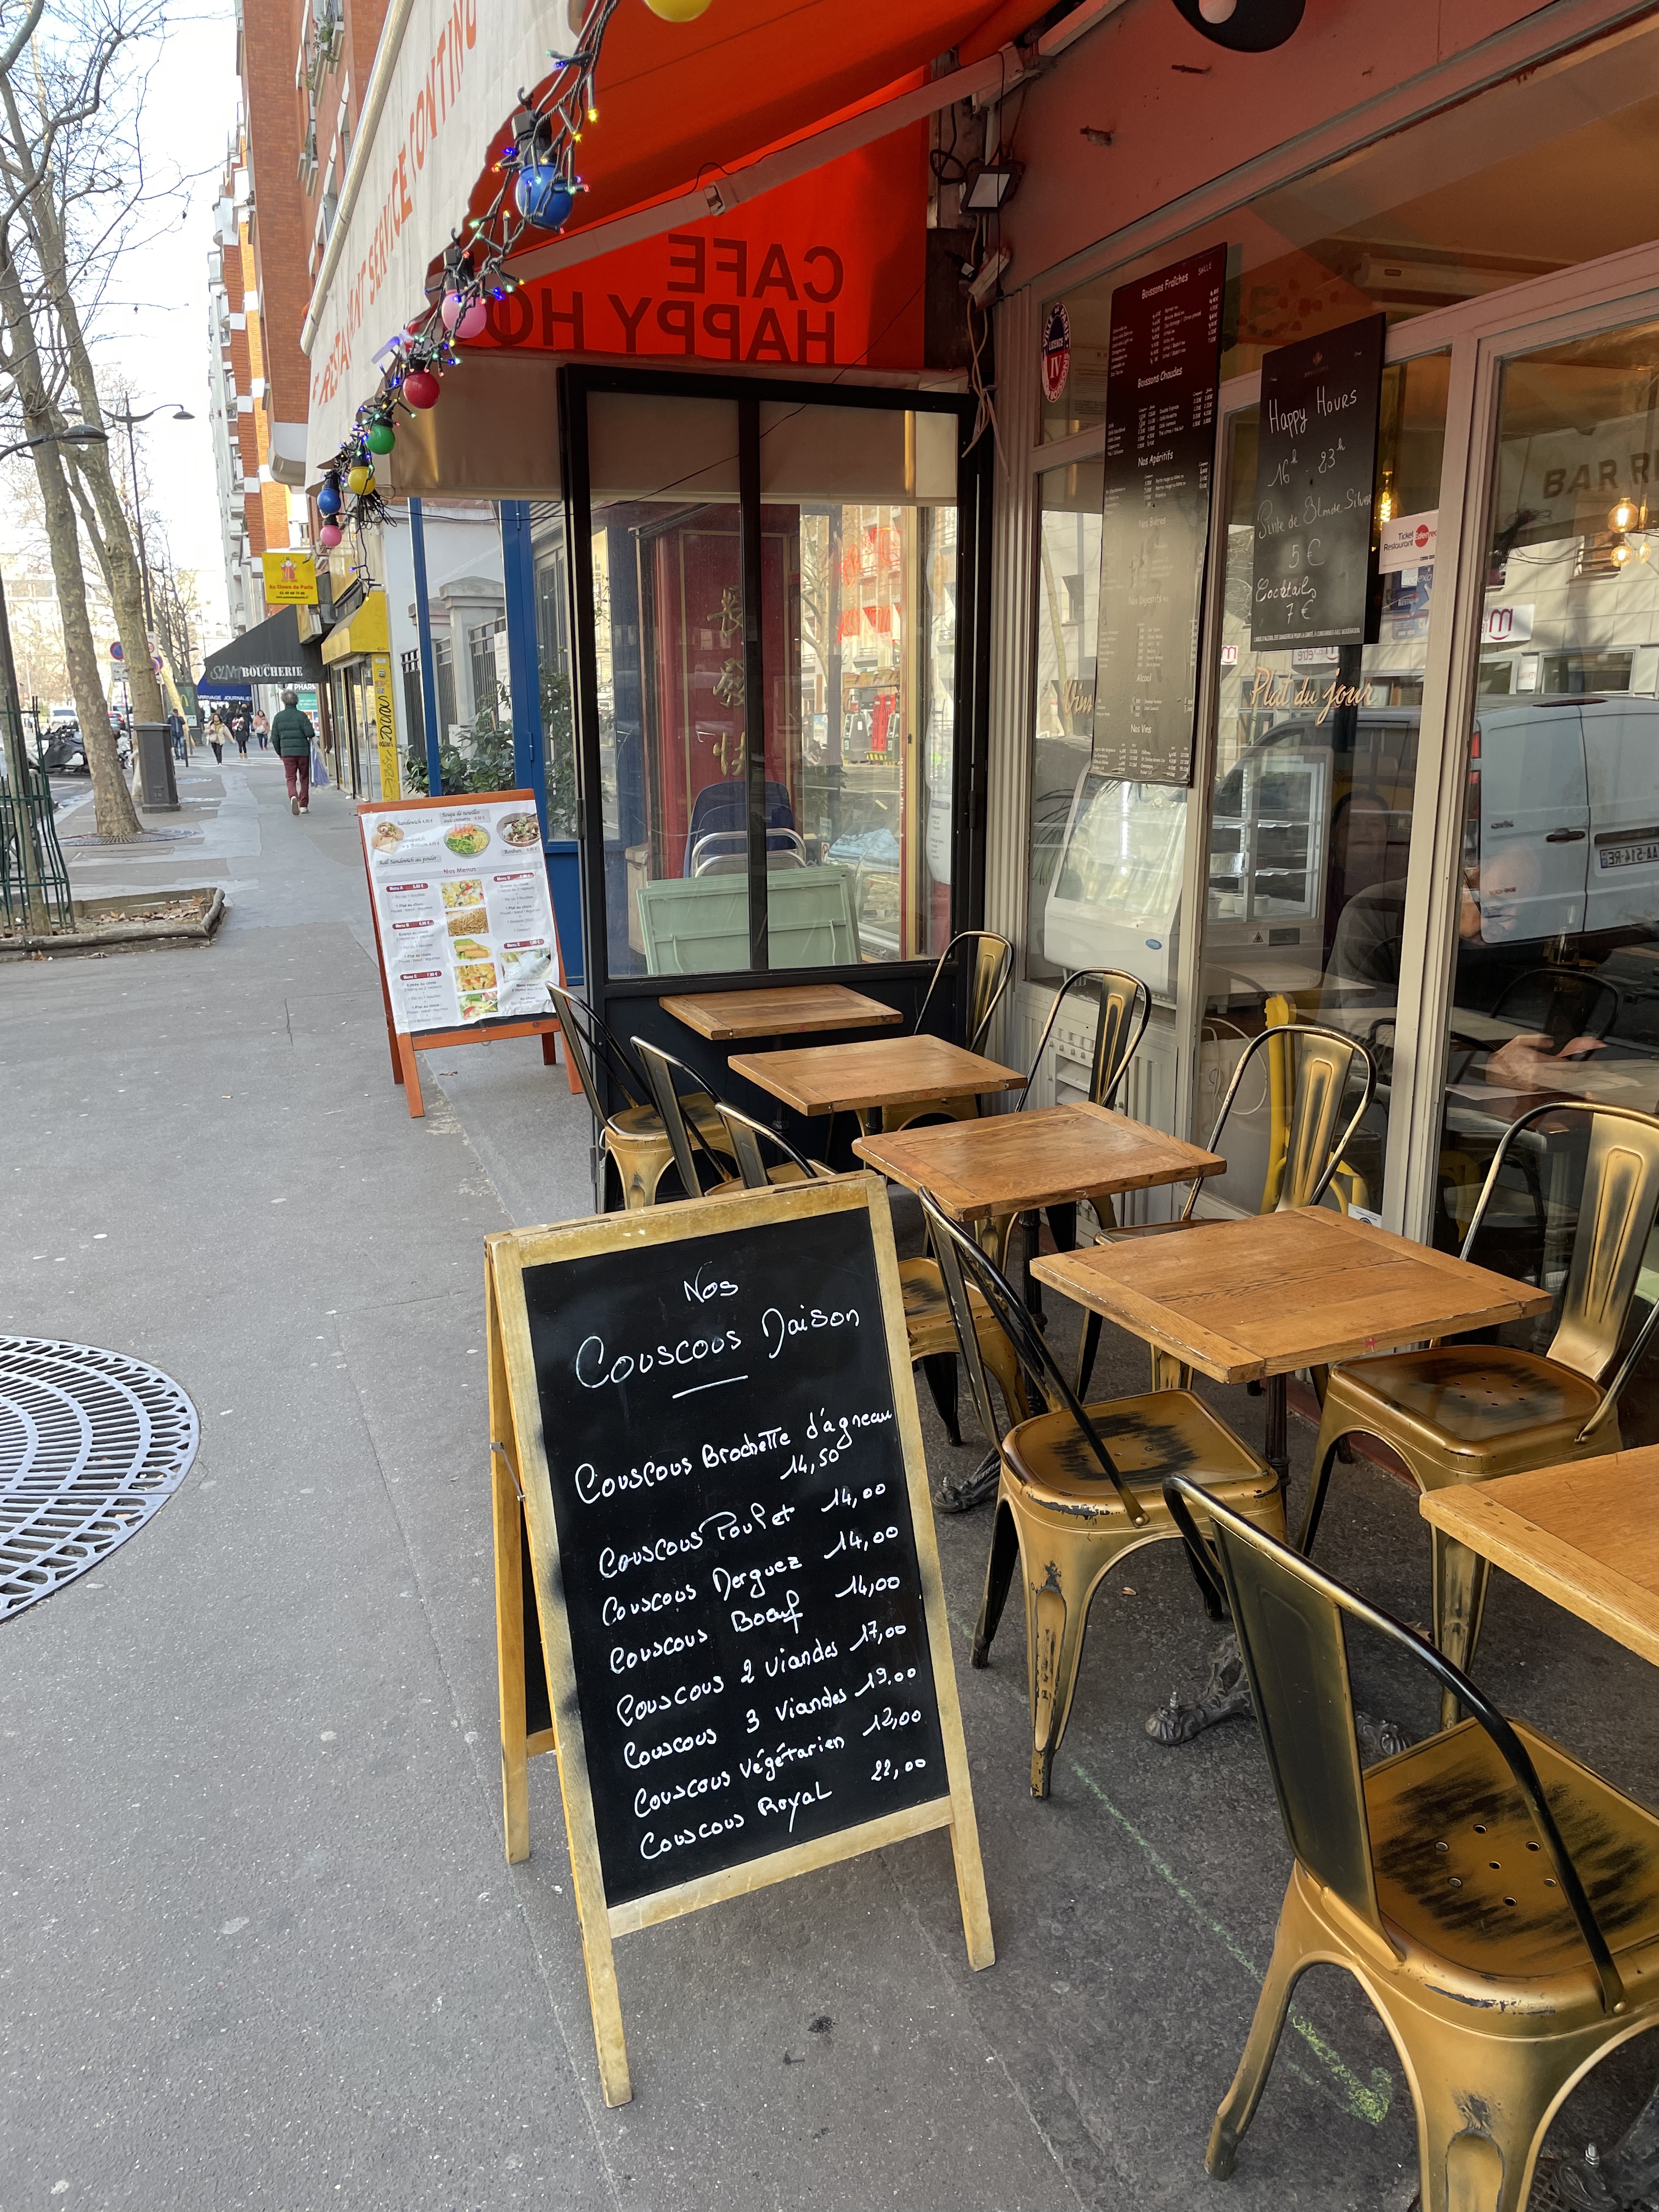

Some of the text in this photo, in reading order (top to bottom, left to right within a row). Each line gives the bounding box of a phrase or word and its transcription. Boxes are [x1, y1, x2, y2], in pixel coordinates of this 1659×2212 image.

[369, 141, 413, 306] SERVICE
[1142, 273, 1188, 299] Boissons Fraîches
[1138, 366, 1183, 388] Boissons Chaudes
[1269, 385, 1357, 438] Happy Hours
[1138, 449, 1173, 467] Nos Apéritifs
[1543, 459, 1619, 499] BAR
[1289, 514, 1301, 529] de
[1303, 496, 1343, 524] Blonde
[1384, 539, 1413, 551] Restaurant
[1398, 530, 1414, 541] Ticket
[1289, 544, 1299, 568] 5
[1128, 596, 1138, 606] Nos
[1139, 593, 1162, 606] Digestifs
[1256, 576, 1317, 602] Cocktails
[241, 666, 303, 678] BOUCHERIE
[1137, 673, 1152, 682] Alcool
[1250, 667, 1378, 726] Plat du jour
[1130, 724, 1152, 733] Nos Vins
[684, 1261, 738, 1302] Nos
[575, 1330, 742, 1389] Couscous
[575, 1458, 692, 1504] Couscous
[702, 1426, 791, 1470] Brochette
[780, 1447, 840, 1480] 14,50
[599, 1483, 886, 1578] Couscous Poulet 14,00
[602, 1583, 697, 1627] Couscous
[823, 1526, 899, 1560] 14,00
[610, 1628, 708, 1674] Couscous
[835, 1574, 901, 1598] 14,00
[616, 1675, 725, 1727] Couscous
[740, 1658, 755, 1684] 2
[849, 1620, 907, 1652] 17,00
[624, 1727, 718, 1770] Couscous
[745, 1708, 760, 1734] 3
[634, 1770, 731, 1818] Couscous
[862, 1706, 922, 1736] 12,00
[640, 1814, 744, 1860] Couscous
[870, 1757, 927, 1782] 22,00
